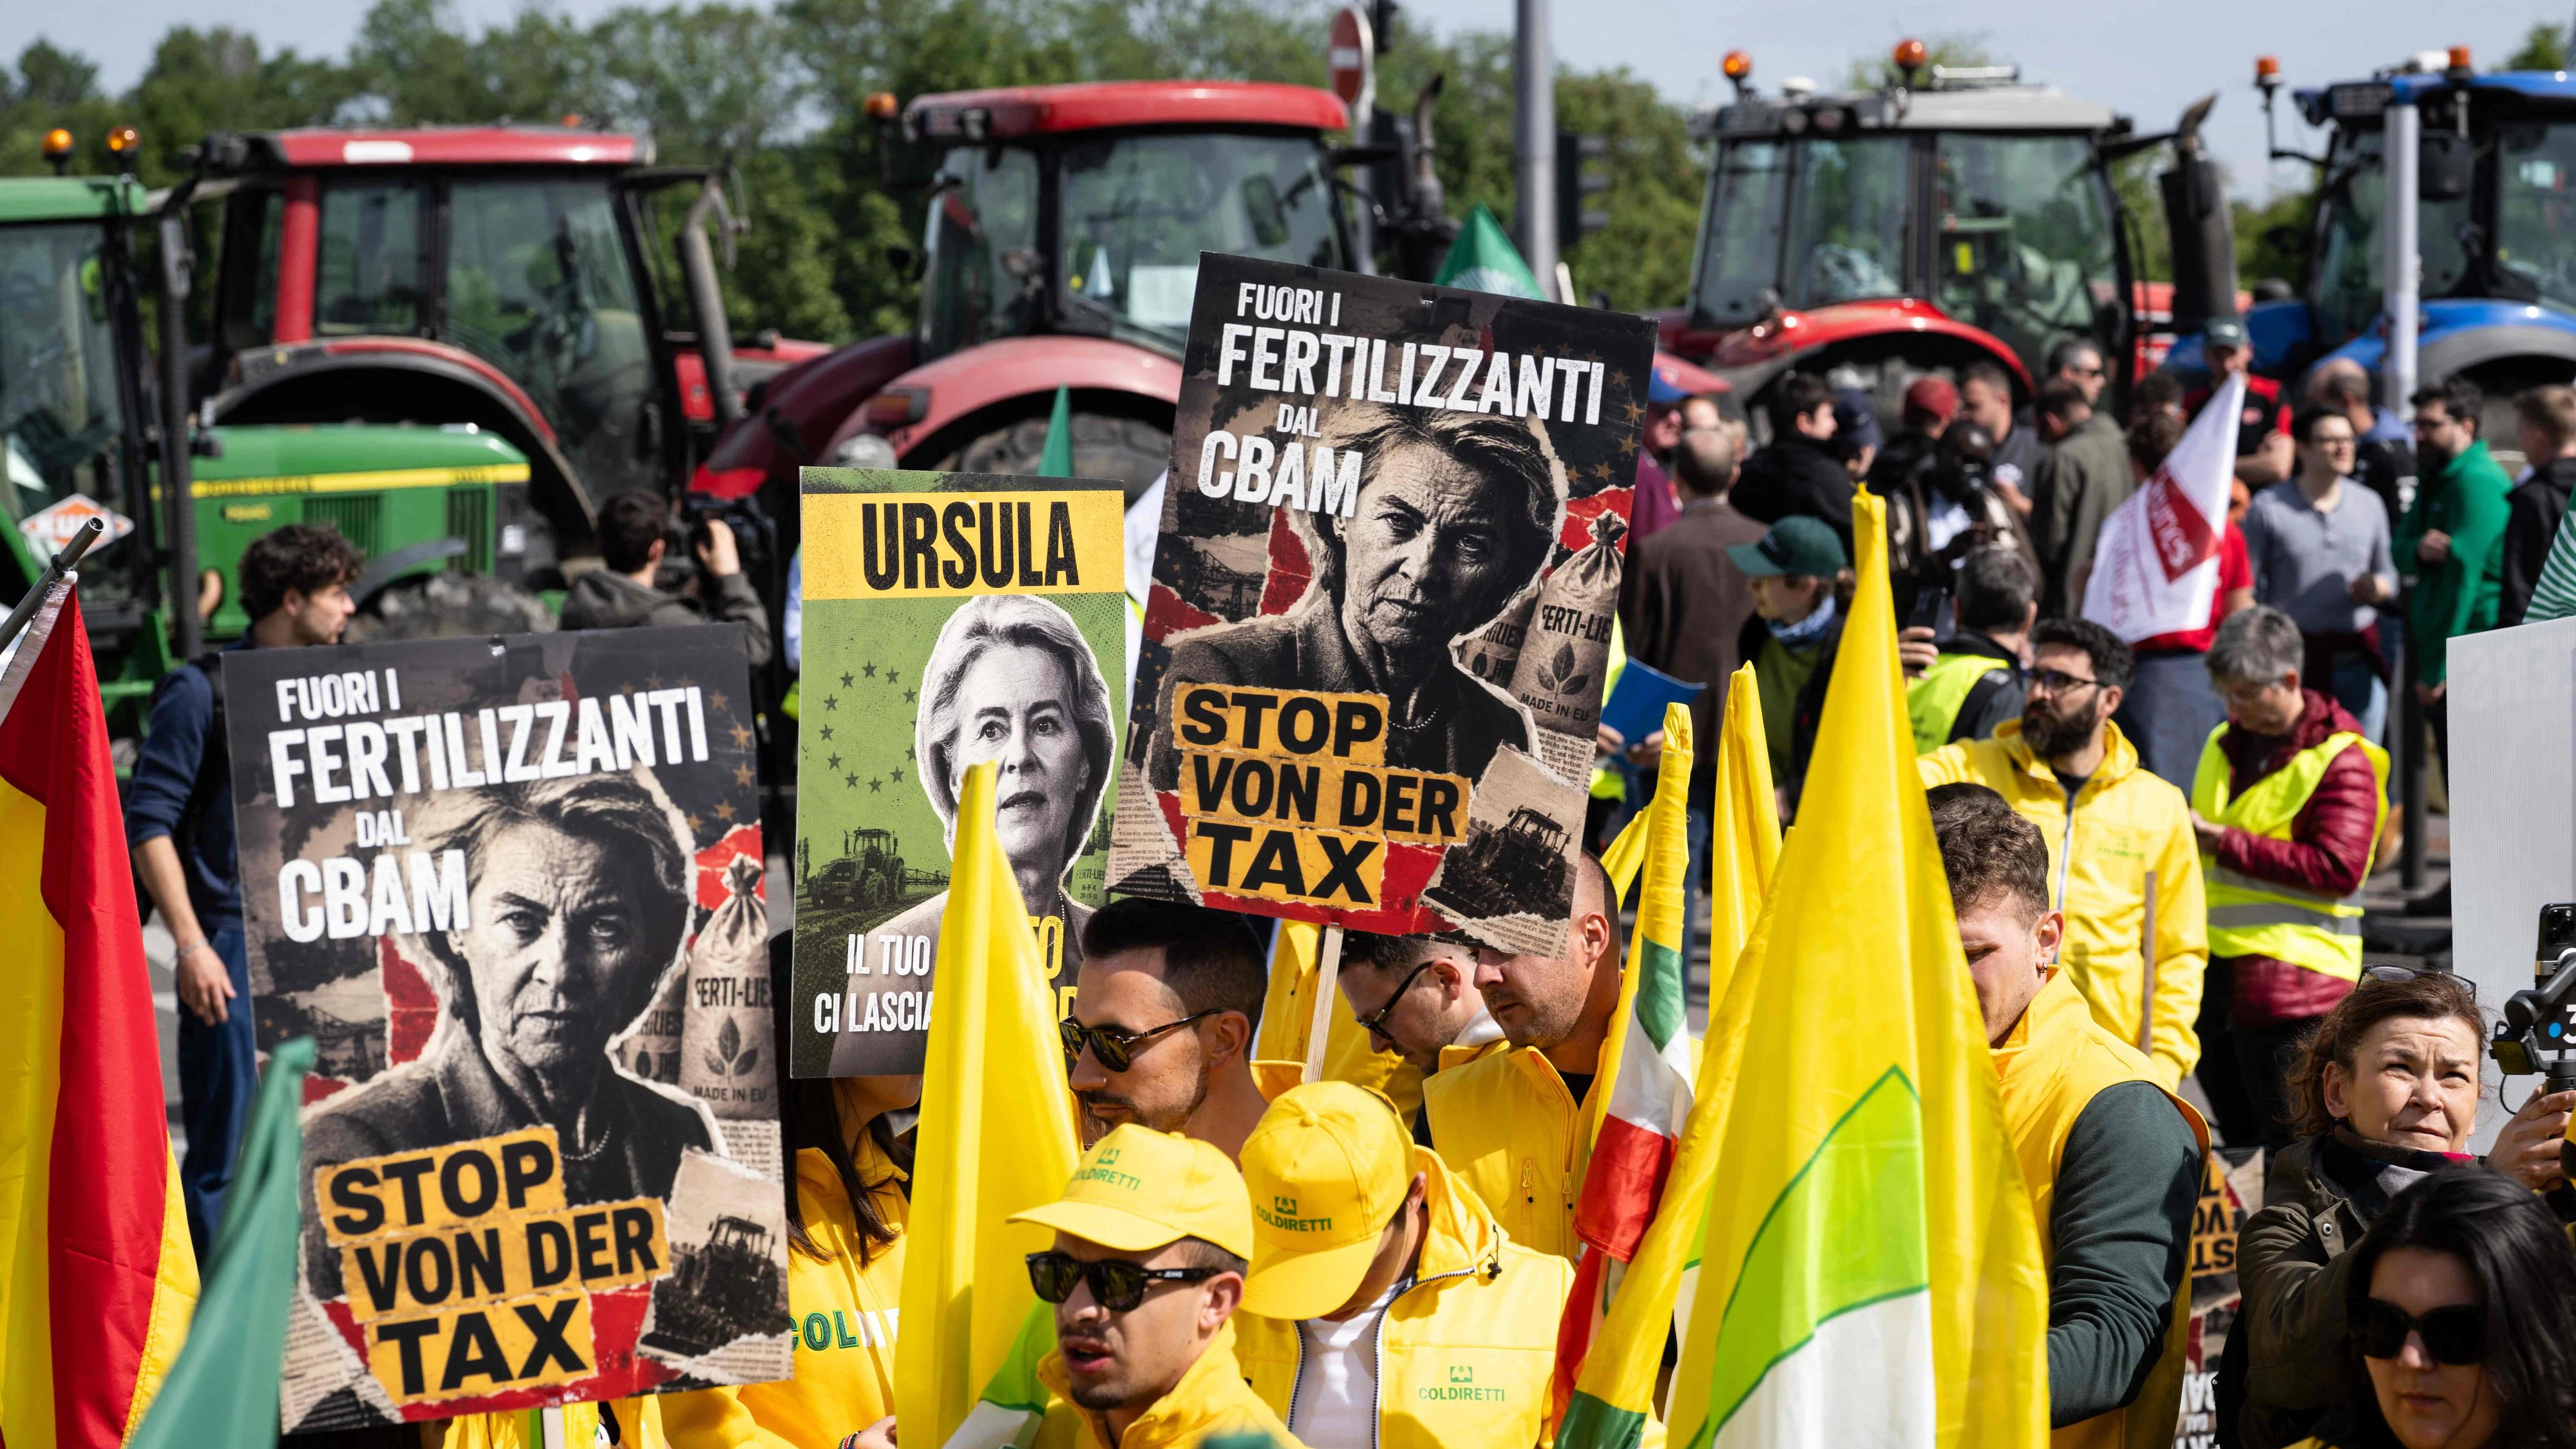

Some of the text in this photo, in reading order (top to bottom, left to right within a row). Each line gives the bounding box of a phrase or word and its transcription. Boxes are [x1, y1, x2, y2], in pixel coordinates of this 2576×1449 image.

[1237, 282, 1341, 327] FUORI I
[1217, 323, 1605, 426] FERTILIZZANTI
[1276, 402, 1321, 438] DAL
[1198, 430, 1363, 518] CBAM
[862, 500, 1080, 591] URSULA
[275, 668, 400, 722] FUORI I
[1180, 688, 1382, 757] STOP
[1520, 692, 1589, 722] MADE IN EU
[268, 686, 710, 808] FERTILIZZANTI
[356, 810, 411, 848] DAL
[1193, 755, 1459, 837] VON DER
[278, 849, 470, 943] CBAM
[1196, 821, 1379, 904] TAX
[847, 933, 931, 976] IL TUO
[814, 992, 840, 1033] CI
[694, 1086, 766, 1102] MADE IN EU
[330, 1140, 555, 1236] STOP
[1256, 1204, 1332, 1232] COLDIRETTI
[355, 1207, 660, 1312] VON DER
[377, 1298, 588, 1396] TAX
[1418, 1387, 1505, 1402] COLDIRETTI
